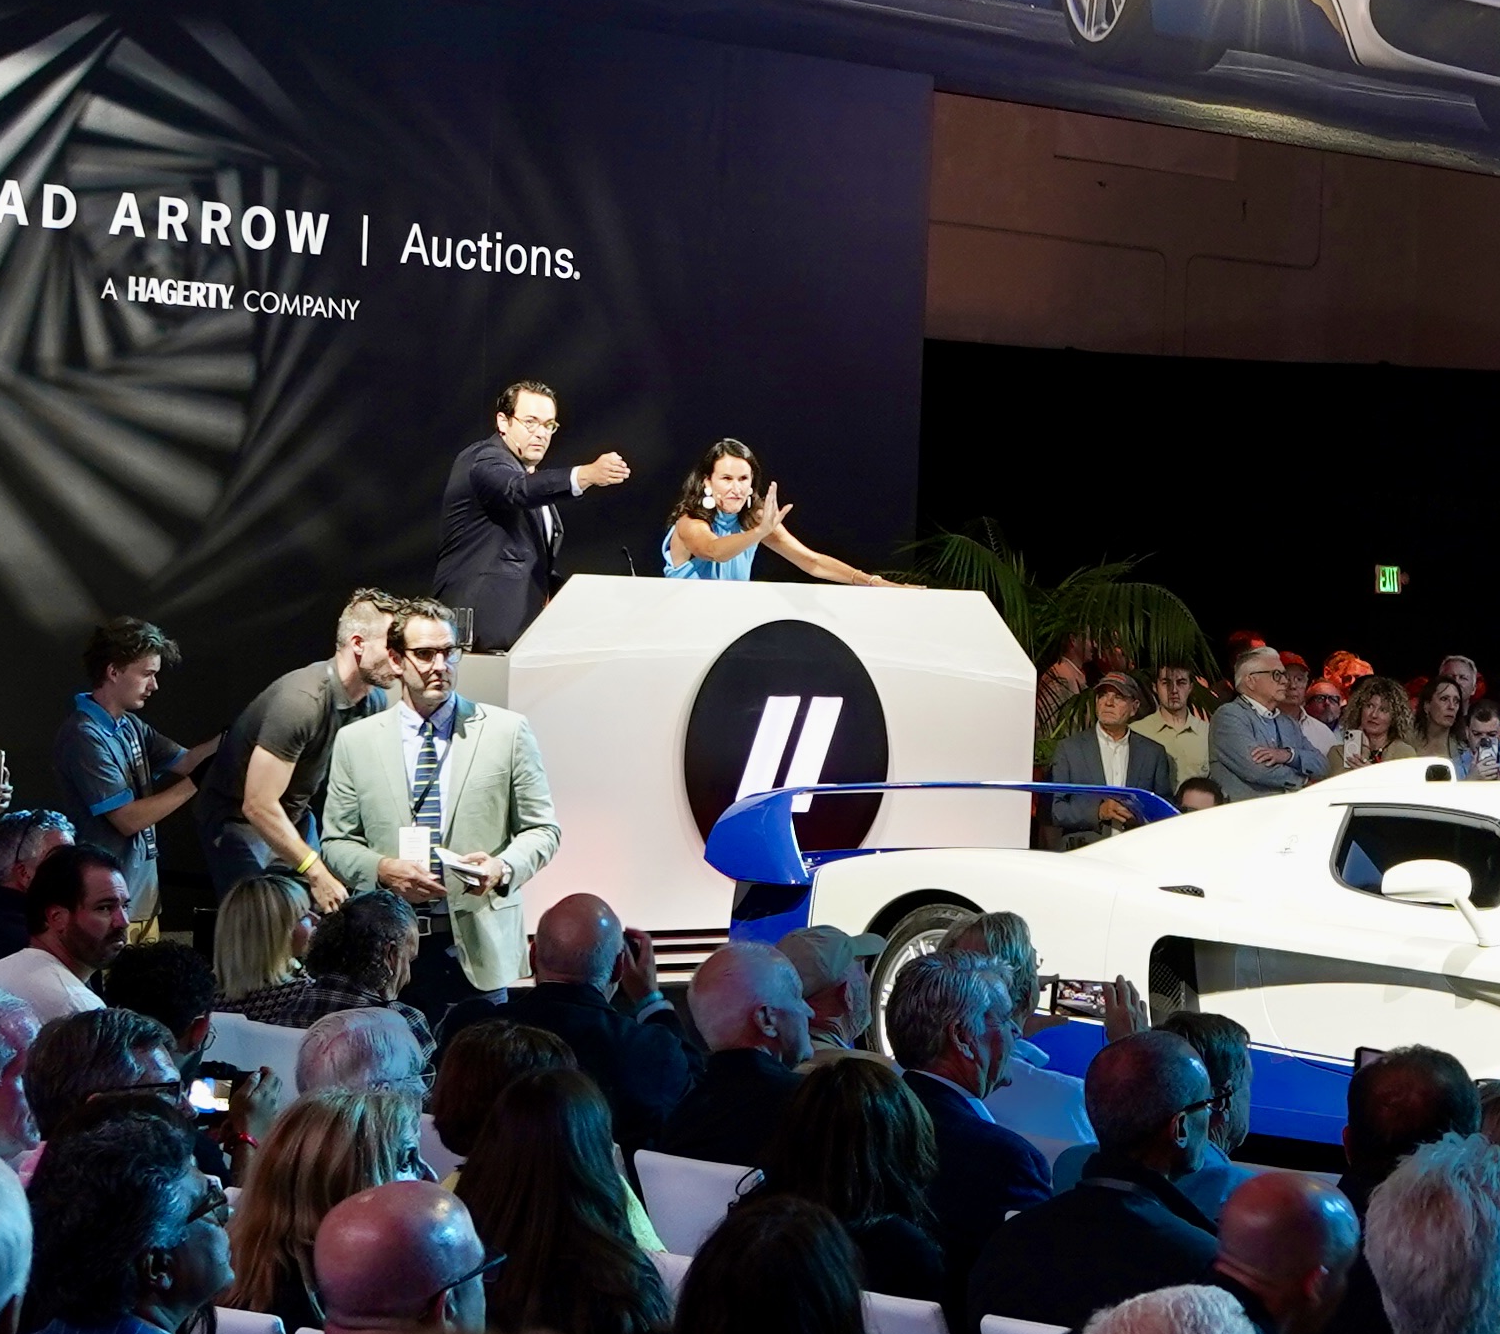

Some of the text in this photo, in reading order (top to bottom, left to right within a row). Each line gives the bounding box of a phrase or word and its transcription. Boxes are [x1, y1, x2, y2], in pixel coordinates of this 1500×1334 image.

[108, 191, 330, 256] ARROW
[100, 276, 119, 301] A
[242, 289, 361, 321] COMPANY
